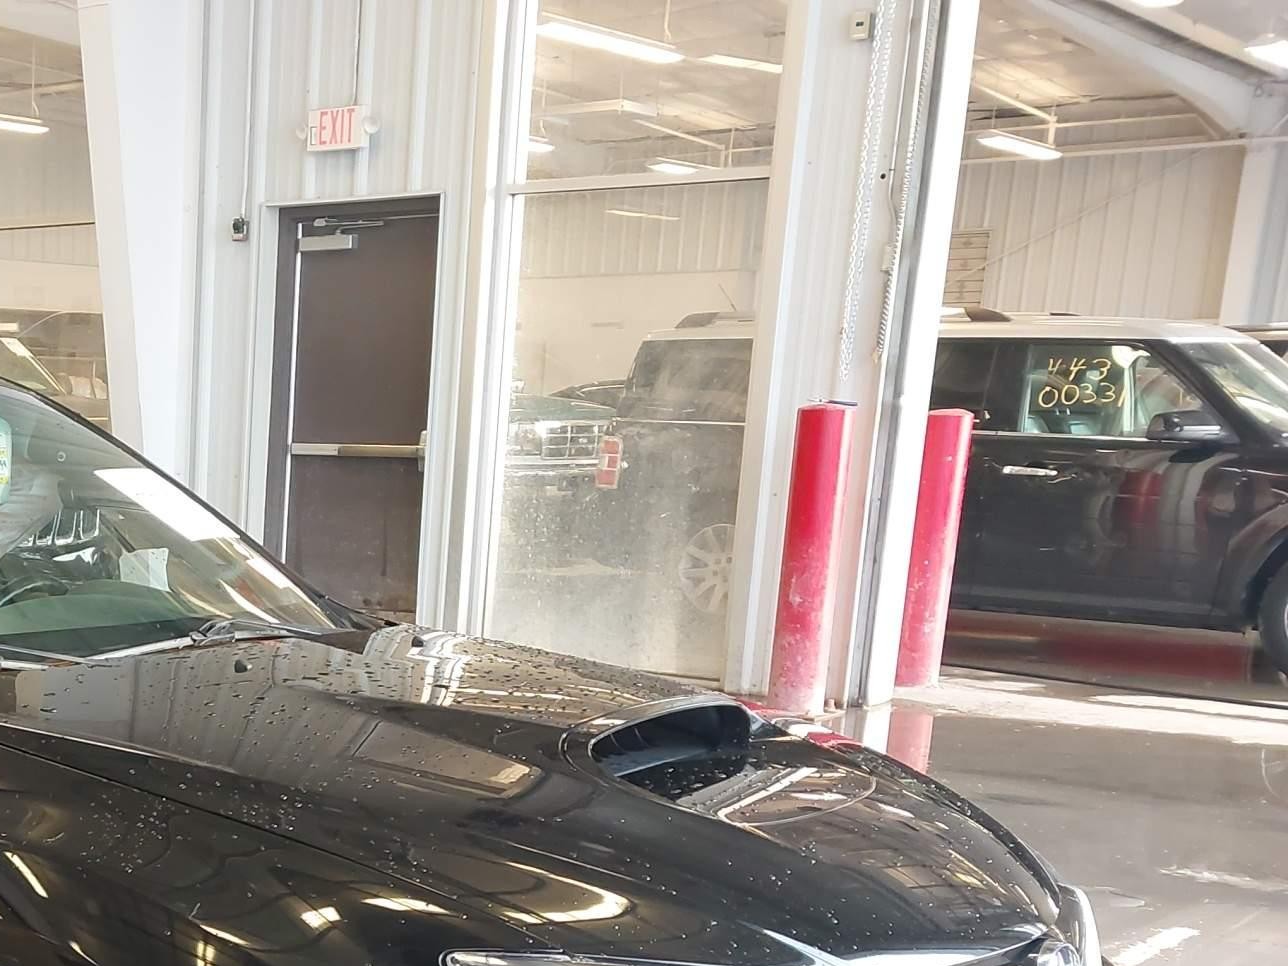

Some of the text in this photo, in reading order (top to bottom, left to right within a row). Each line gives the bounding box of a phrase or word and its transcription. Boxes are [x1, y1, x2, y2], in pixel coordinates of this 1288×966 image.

[319, 108, 355, 145] EXIT
[1048, 358, 1112, 381] 443
[1038, 382, 1128, 408] 00331
